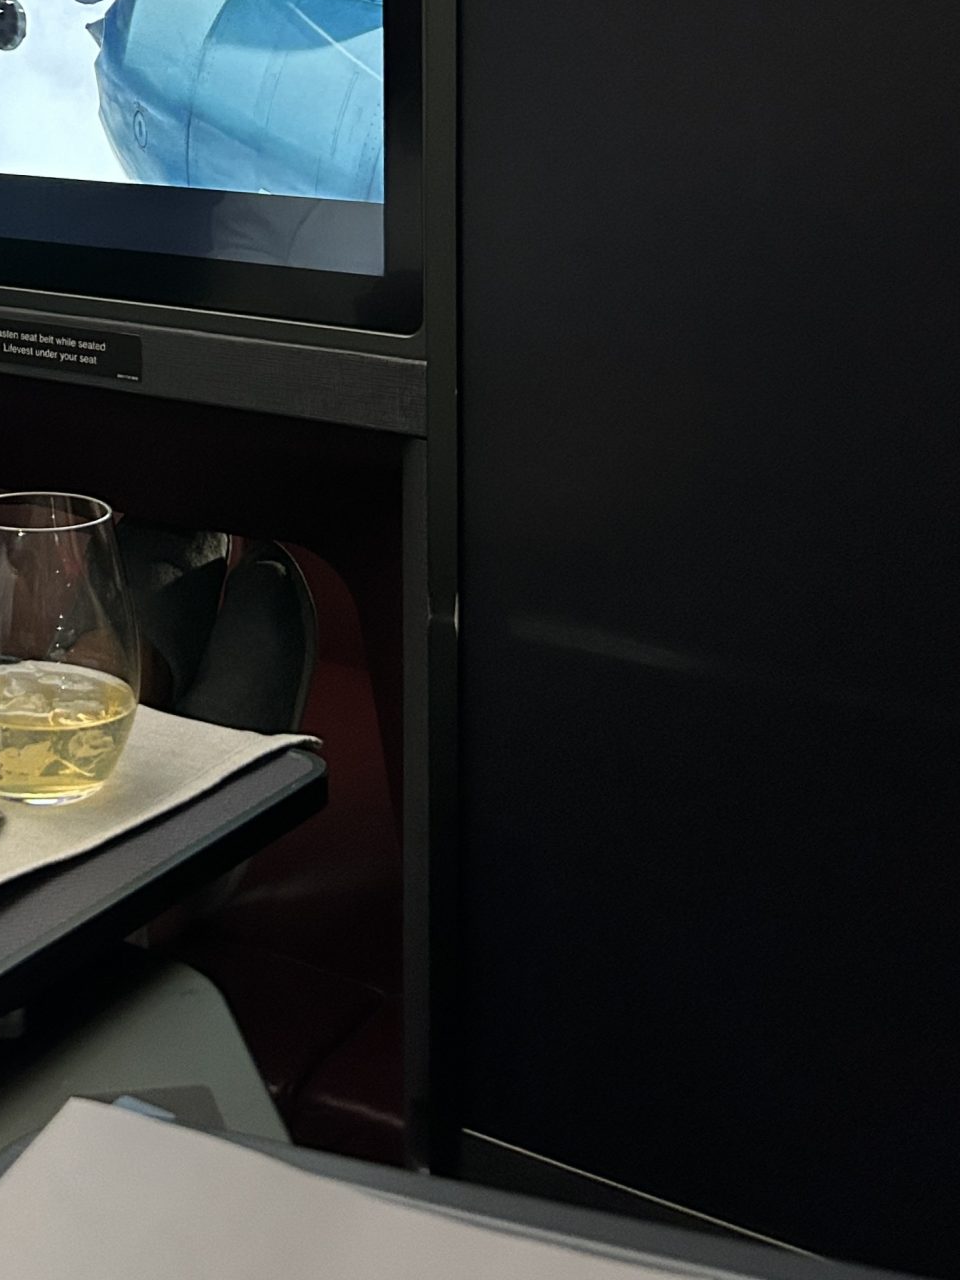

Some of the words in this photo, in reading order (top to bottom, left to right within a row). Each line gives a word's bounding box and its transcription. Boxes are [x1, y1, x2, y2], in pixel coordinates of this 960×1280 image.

[20, 332, 38, 342] seat
[39, 333, 54, 344] belt
[55, 336, 77, 348] while
[78, 340, 106, 352] seated
[3, 342, 34, 356] Lifevest
[35, 348, 58, 359] under
[59, 351, 78, 362] your
[79, 354, 97, 365] seat
